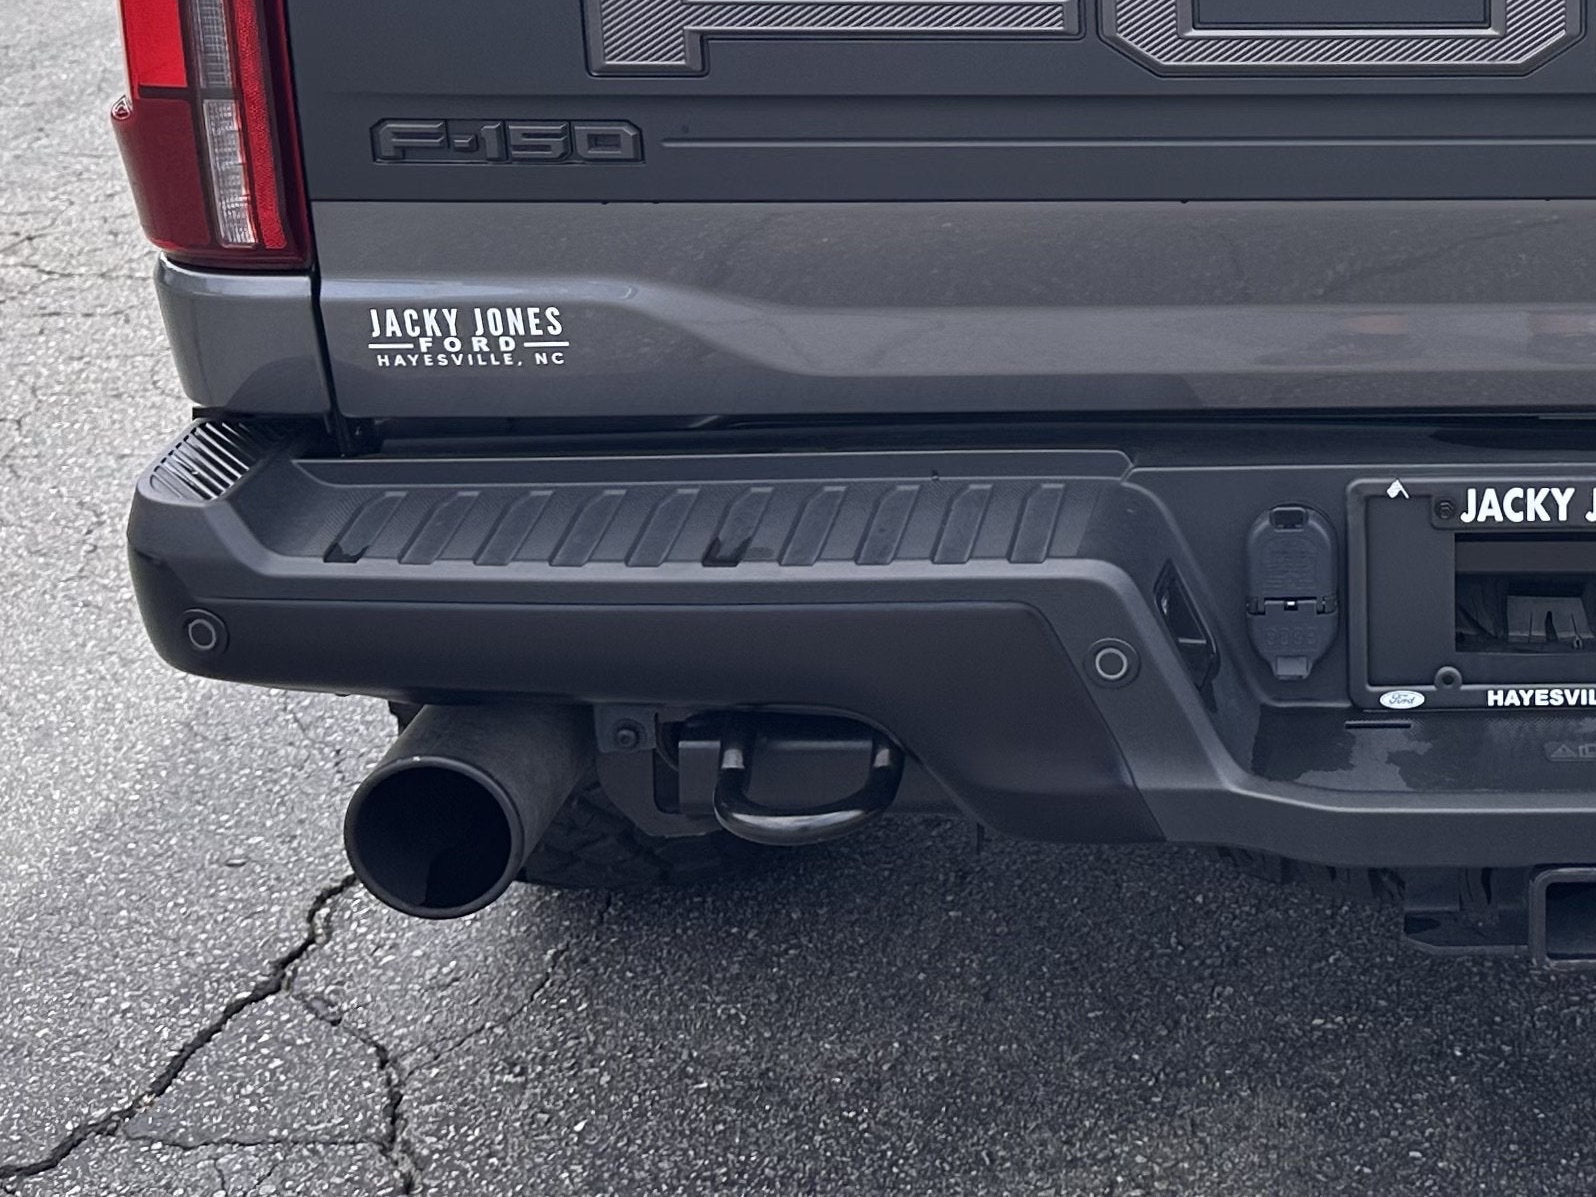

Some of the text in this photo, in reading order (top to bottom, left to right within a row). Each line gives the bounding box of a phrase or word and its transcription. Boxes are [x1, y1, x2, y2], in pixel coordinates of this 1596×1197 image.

[370, 118, 644, 165] F-150
[369, 306, 563, 338] JACKY JONES
[376, 352, 565, 367] HAYESVILLE, NC
[418, 336, 516, 353] FORD
[1460, 487, 1576, 523] JACKY
